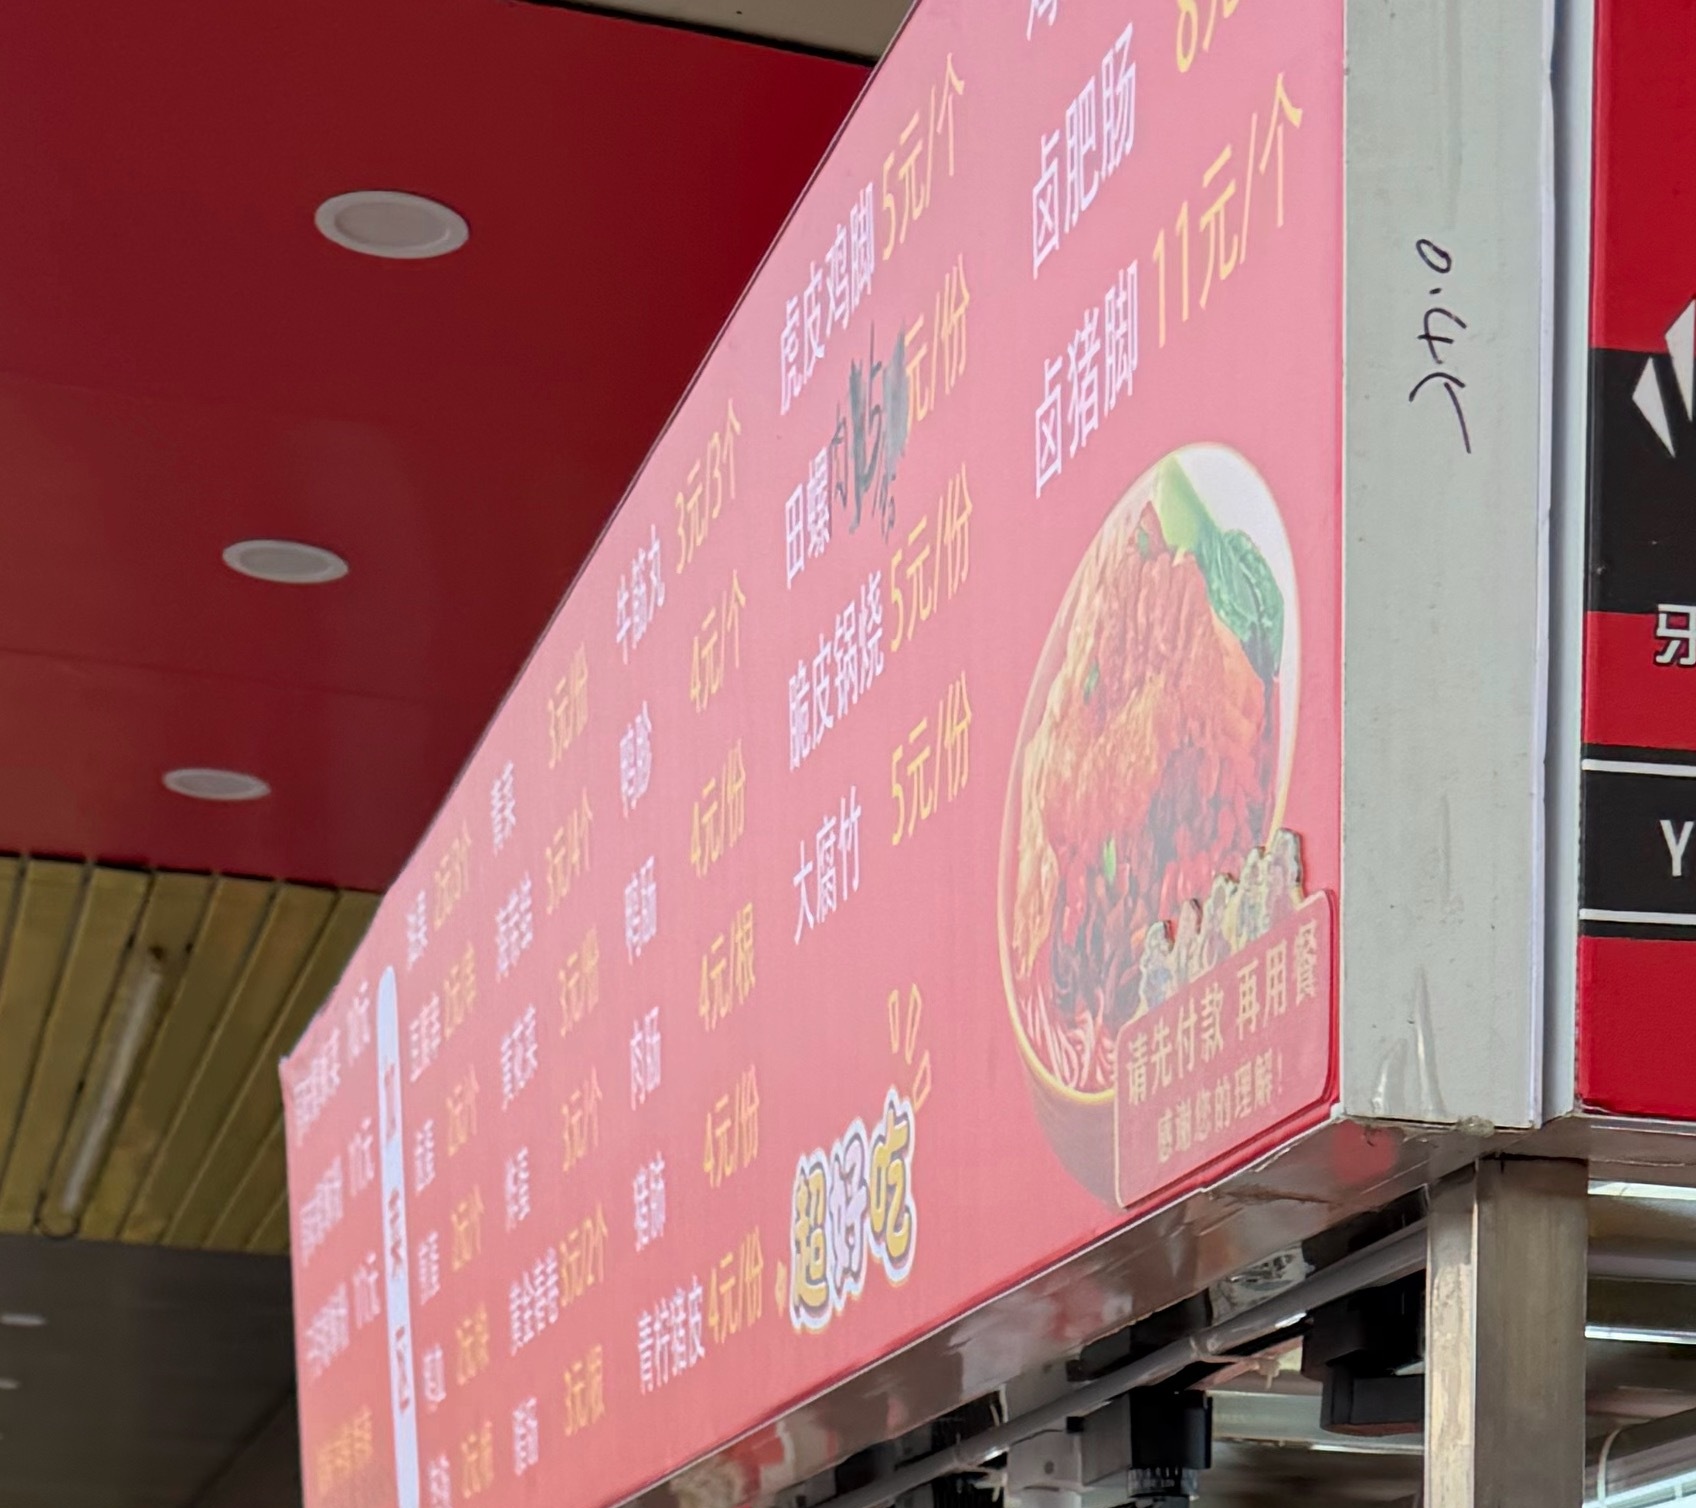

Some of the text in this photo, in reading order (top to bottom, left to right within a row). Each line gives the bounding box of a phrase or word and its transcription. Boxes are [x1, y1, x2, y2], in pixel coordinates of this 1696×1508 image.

[778, 48, 965, 415] 虎皮鸡脚 5元/个
[1030, 23, 1137, 274] 卤肥肠
[1033, 73, 1302, 493] 卤猪脚 11元/个
[673, 399, 741, 572] 3元/3个
[688, 568, 747, 719] 4元/个
[787, 467, 973, 768] 脆皮锅烧 5元/份
[688, 746, 746, 885] 4元/份
[792, 678, 972, 941] 大腐竹 5元/份
[1127, 919, 1316, 1105] 请先付款 再用餐
[701, 1071, 760, 1191] 4元/份
[791, 1094, 914, 1324] 超好吃
[706, 1235, 764, 1342] 4元/份
